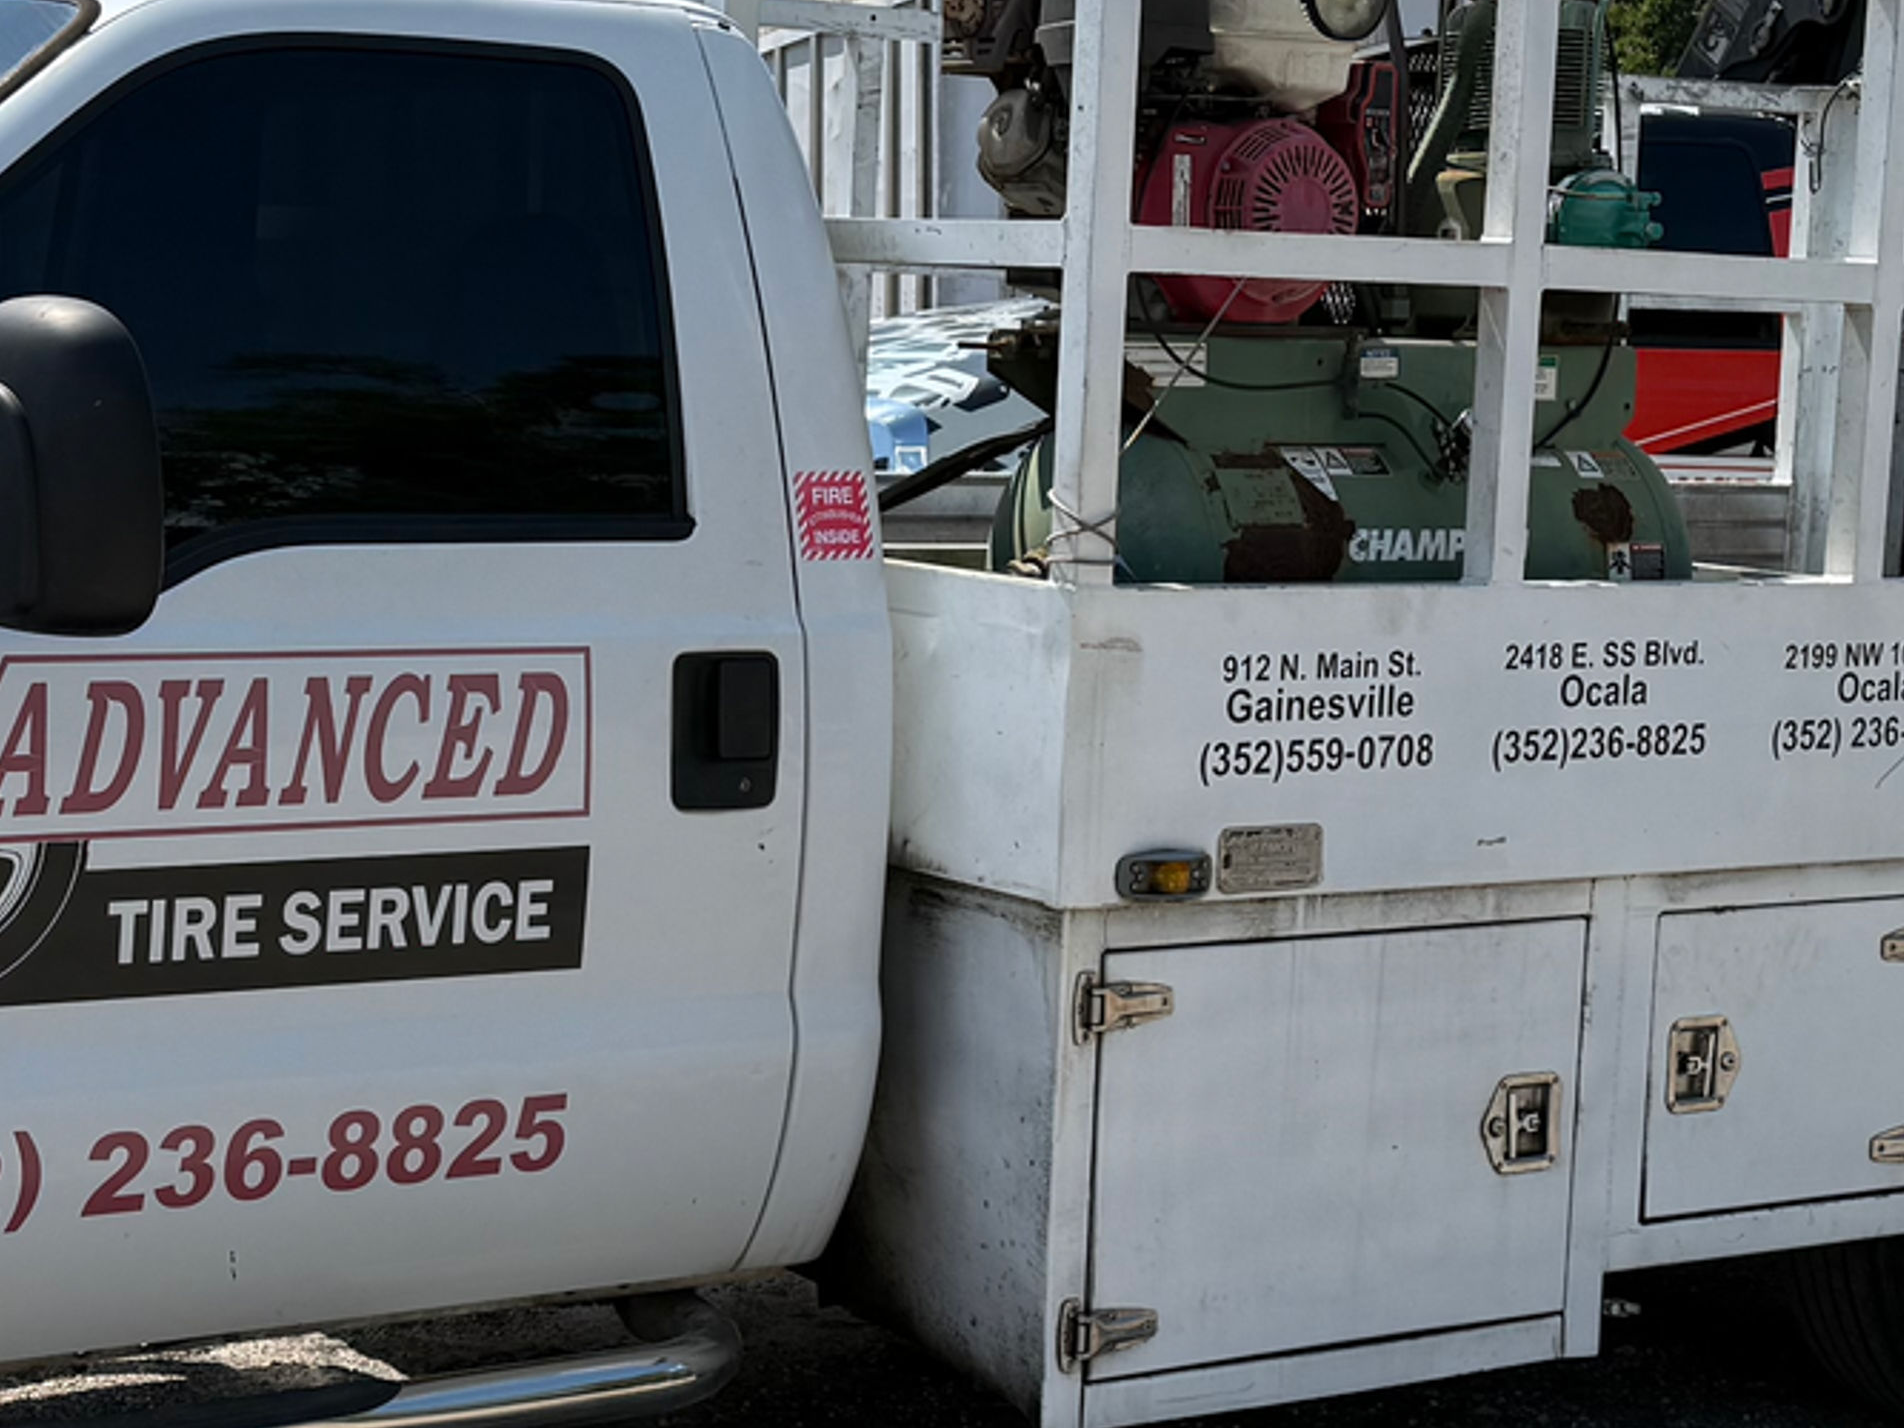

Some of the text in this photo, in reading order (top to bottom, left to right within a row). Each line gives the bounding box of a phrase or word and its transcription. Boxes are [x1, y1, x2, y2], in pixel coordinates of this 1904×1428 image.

[812, 485, 853, 505] FIRE
[812, 528, 861, 544] INSIDE
[1348, 528, 1466, 562] CHAMP
[1222, 650, 1422, 682] 912 N. Main St.
[1505, 639, 1705, 670] 2418 E. SS Blvd.
[1784, 643, 1838, 670] 2199
[1845, 642, 1884, 667] NW
[1226, 684, 1415, 724] Gainesville
[1560, 673, 1647, 707] Ocala
[1492, 723, 1706, 772] (352)236-8825
[1772, 717, 1842, 760] (352)
[1200, 733, 1433, 786] (352)559-0708
[107, 879, 555, 965] TIRE SERVICE
[79, 1092, 568, 1218] 236-8825
